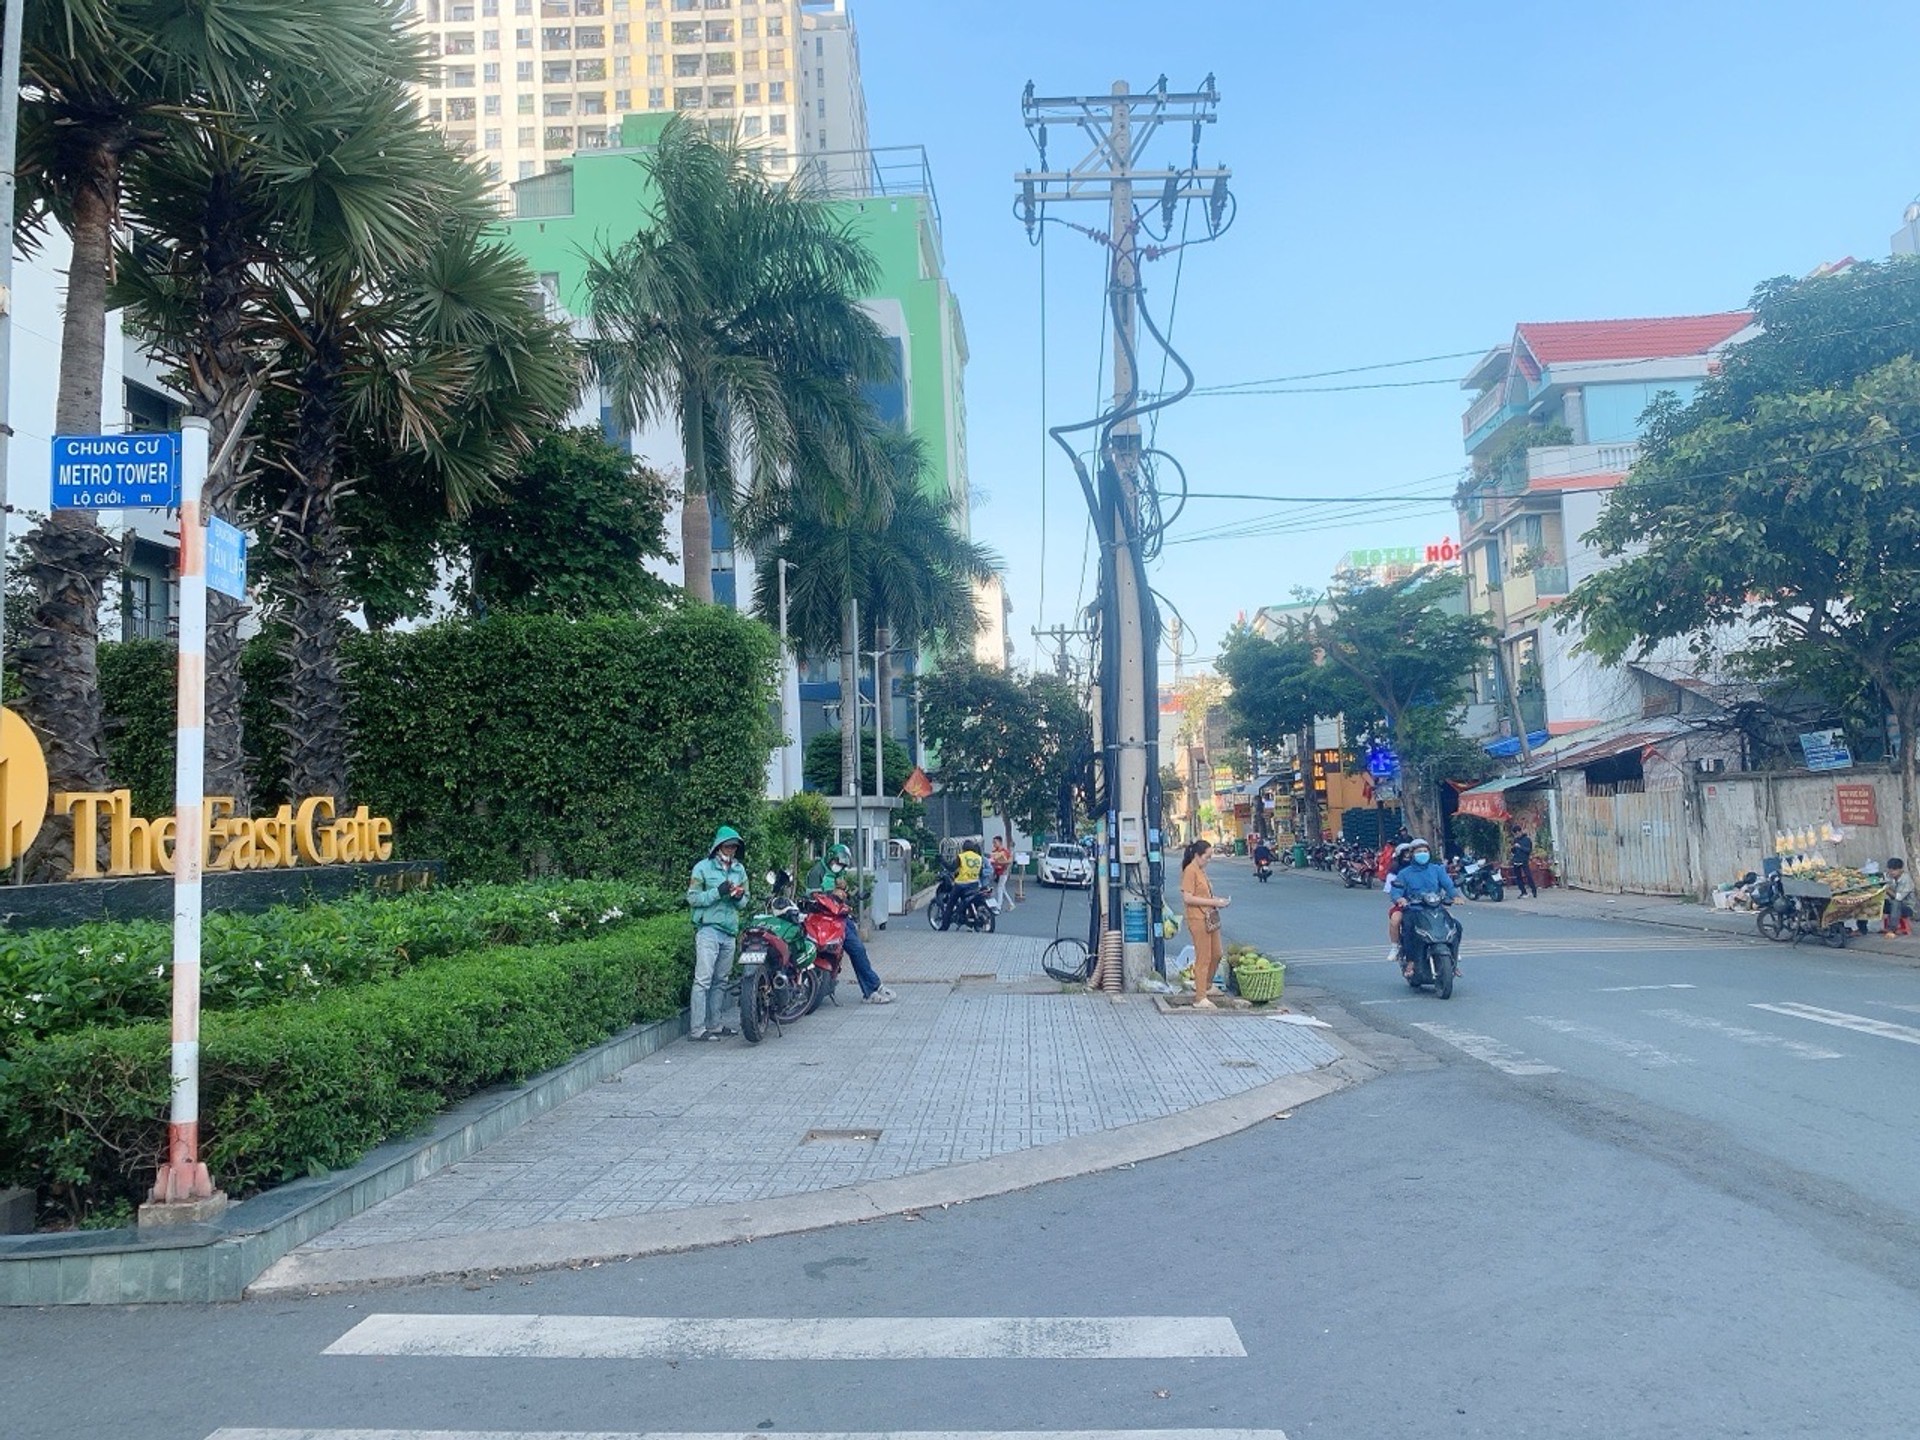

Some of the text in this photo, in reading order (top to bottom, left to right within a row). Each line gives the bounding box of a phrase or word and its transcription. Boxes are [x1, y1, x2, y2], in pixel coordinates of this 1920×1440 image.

[67, 438, 160, 455] CHUNG CƯ
[59, 462, 168, 485] METRO TOWER
[73, 490, 91, 508] LỘ
[140, 493, 152, 502] m
[54, 789, 176, 879] The
